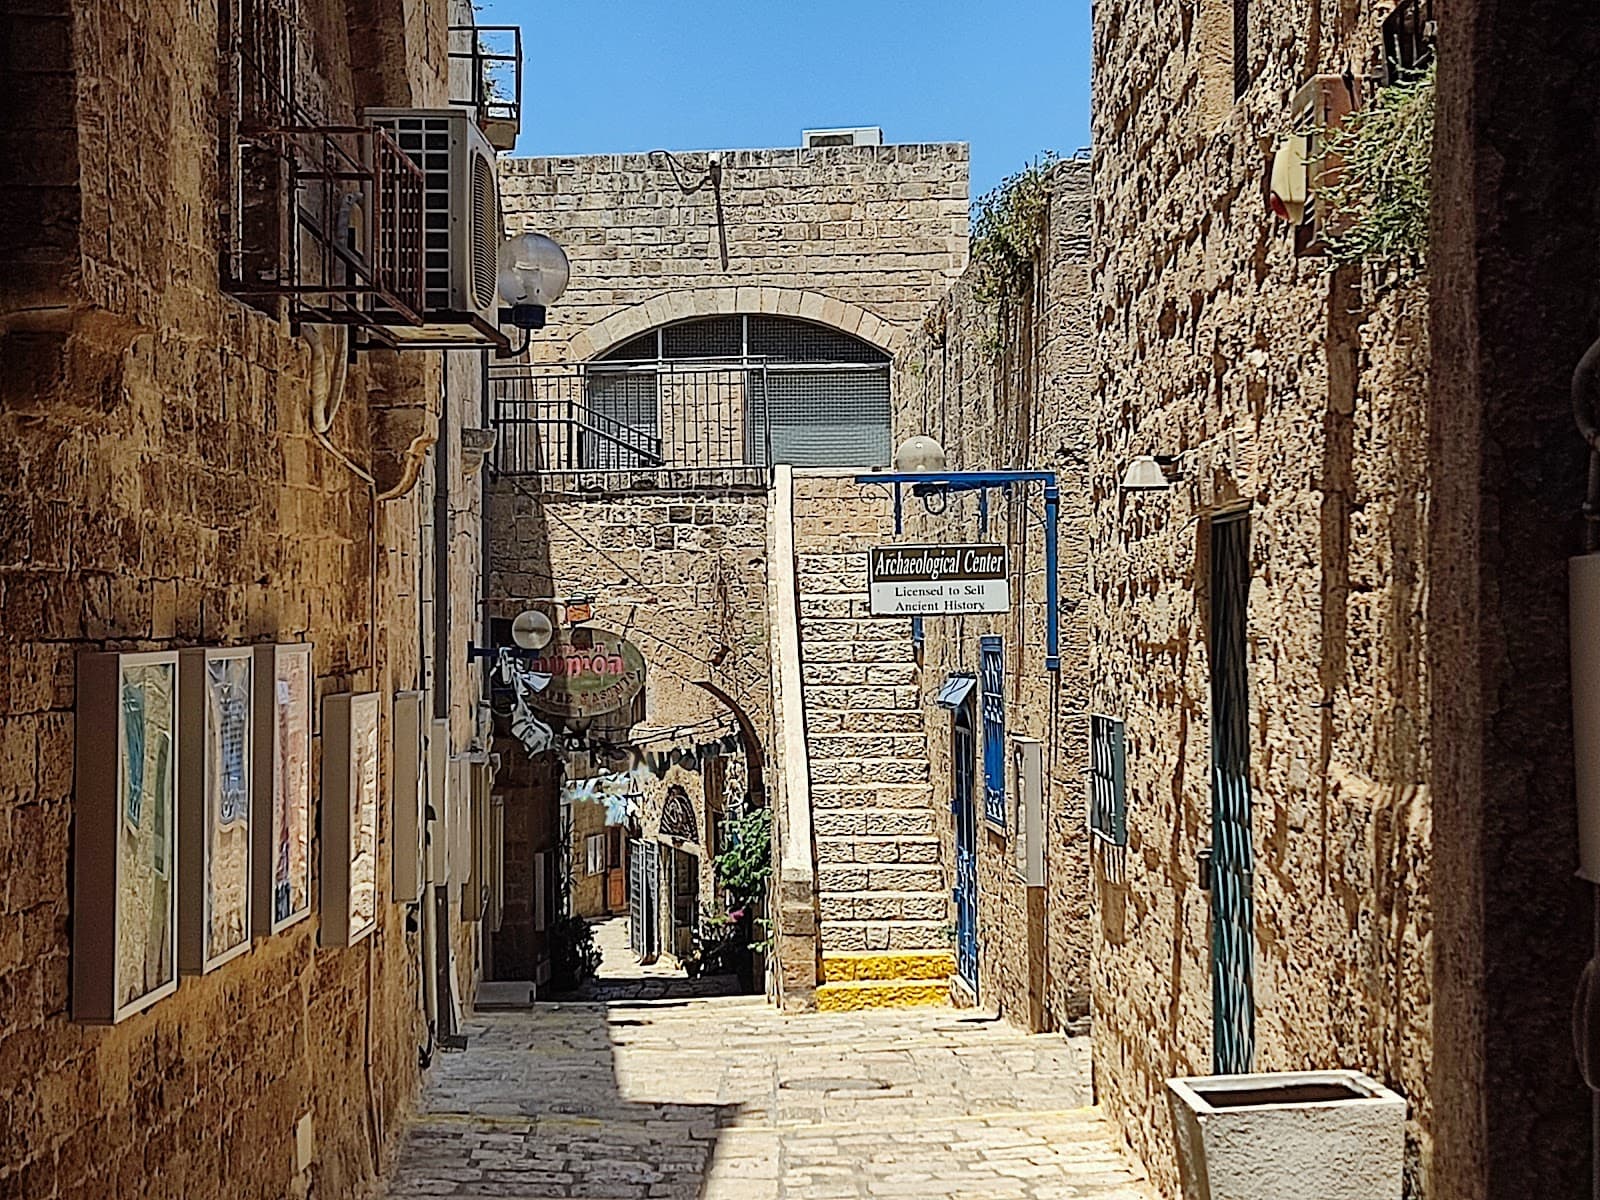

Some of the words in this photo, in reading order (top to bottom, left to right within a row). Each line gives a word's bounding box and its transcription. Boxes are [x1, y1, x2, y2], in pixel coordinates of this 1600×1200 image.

[875, 550, 961, 580] Archaeological
[964, 550, 1003, 573] Center
[895, 586, 944, 597] Licensed
[949, 587, 960, 596] to
[964, 585, 985, 596] Sell
[896, 602, 938, 612] Ancient
[944, 600, 985, 611] History
